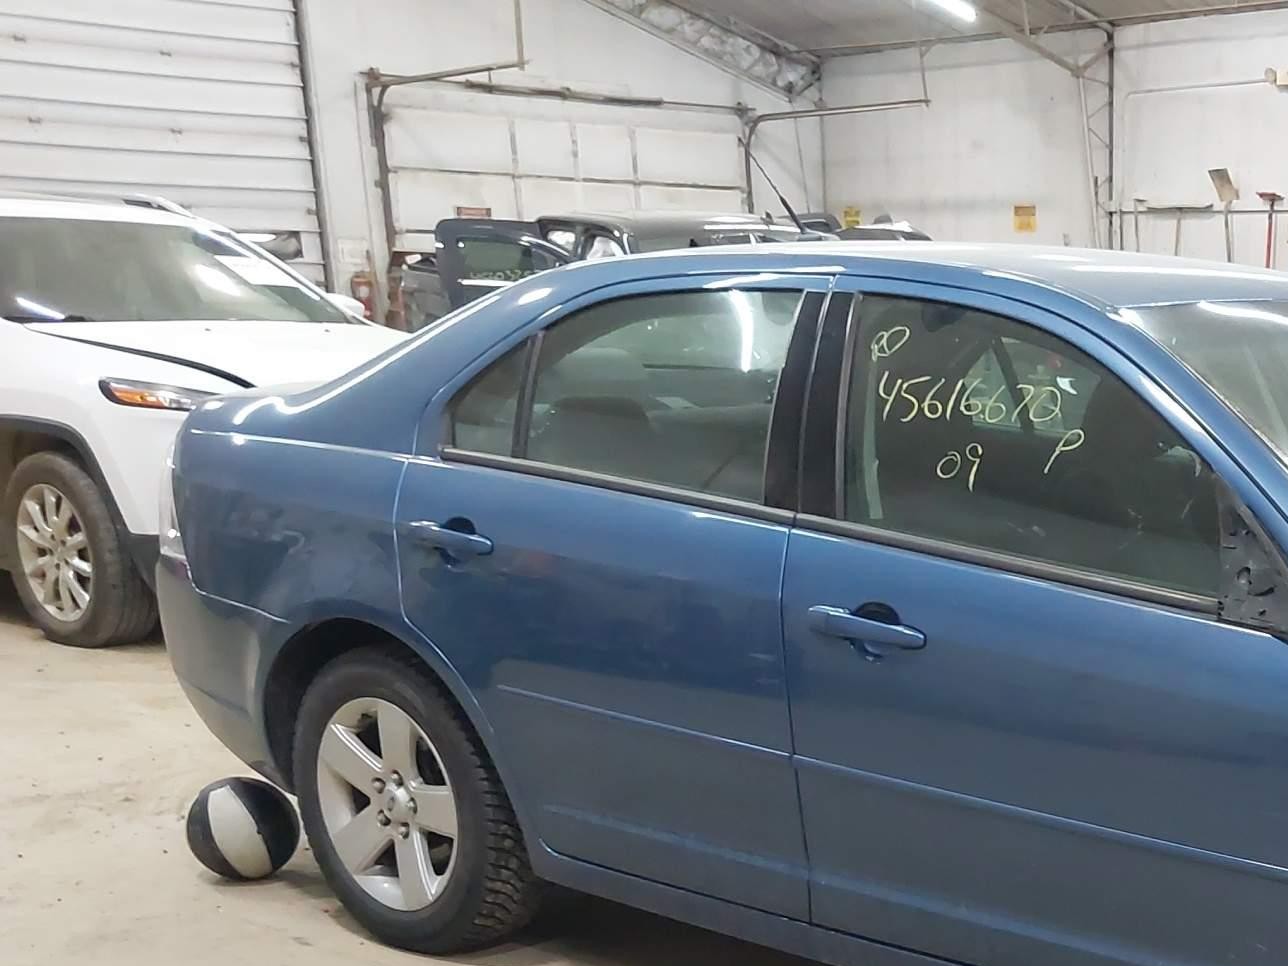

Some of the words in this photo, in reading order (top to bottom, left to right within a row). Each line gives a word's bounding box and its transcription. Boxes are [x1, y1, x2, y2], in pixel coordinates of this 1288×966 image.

[879, 371, 1063, 423] 45616670
[936, 442, 983, 493] 09
[1043, 428, 1085, 474] P
